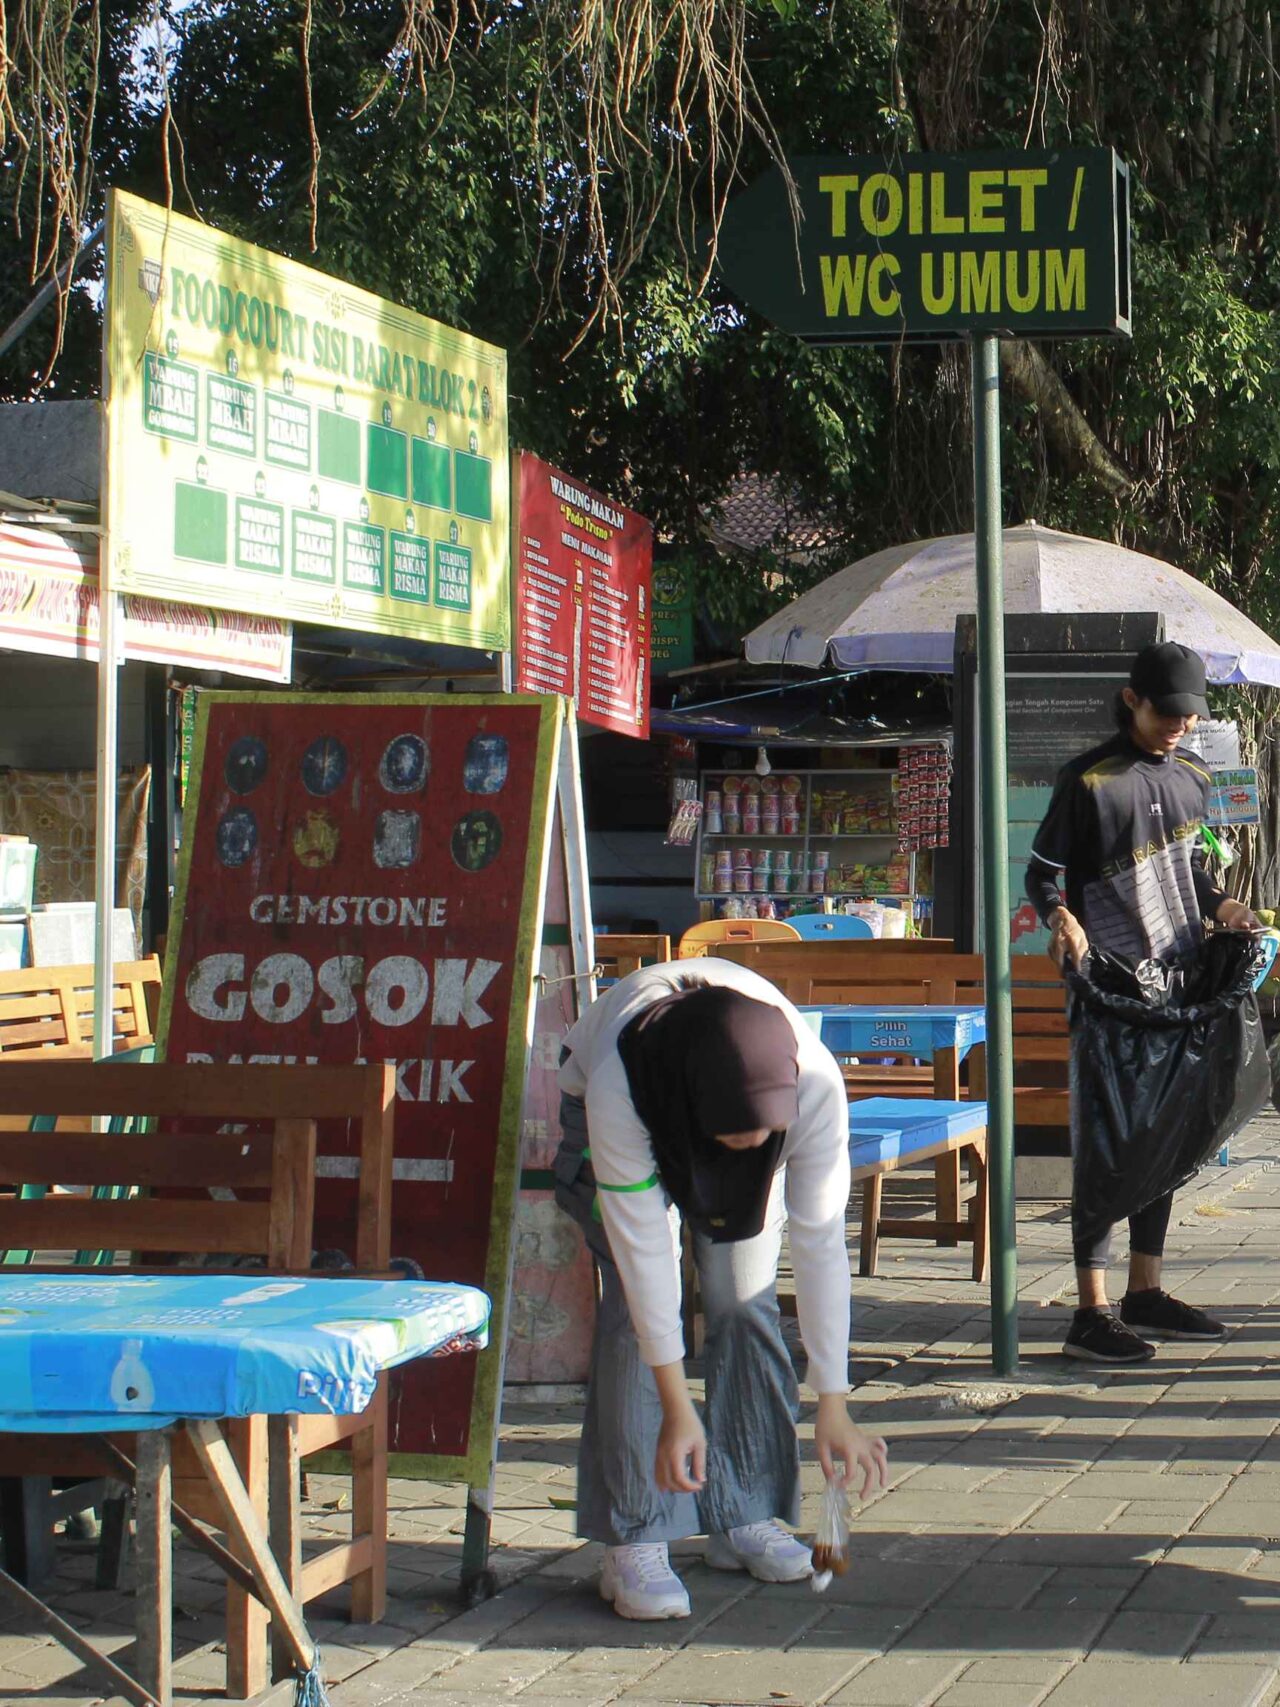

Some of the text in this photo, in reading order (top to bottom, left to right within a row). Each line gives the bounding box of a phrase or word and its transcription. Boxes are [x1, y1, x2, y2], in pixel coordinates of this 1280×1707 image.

[819, 166, 1085, 237] TOILET /
[819, 249, 1087, 317] WC UMUM
[171, 266, 308, 361] FOODCOURT
[313, 320, 350, 378] SISI
[353, 336, 414, 402] BARAT
[418, 355, 466, 419] BLOK
[467, 379, 480, 421] 2
[550, 476, 625, 531] WARUNG MAKAN
[394, 539, 427, 559] WARUNG
[438, 550, 469, 569] WARUNG
[581, 540, 613, 567] MAKANAN
[347, 562, 382, 586] RISMA
[394, 554, 427, 577] MAKAN
[438, 564, 469, 585] MAKAN
[394, 572, 427, 595] RISMA
[438, 580, 469, 604] RISMA
[249, 894, 448, 927] GEMSTONE
[185, 952, 503, 1030] GOSOK
[871, 1035, 912, 1047] Sehat
